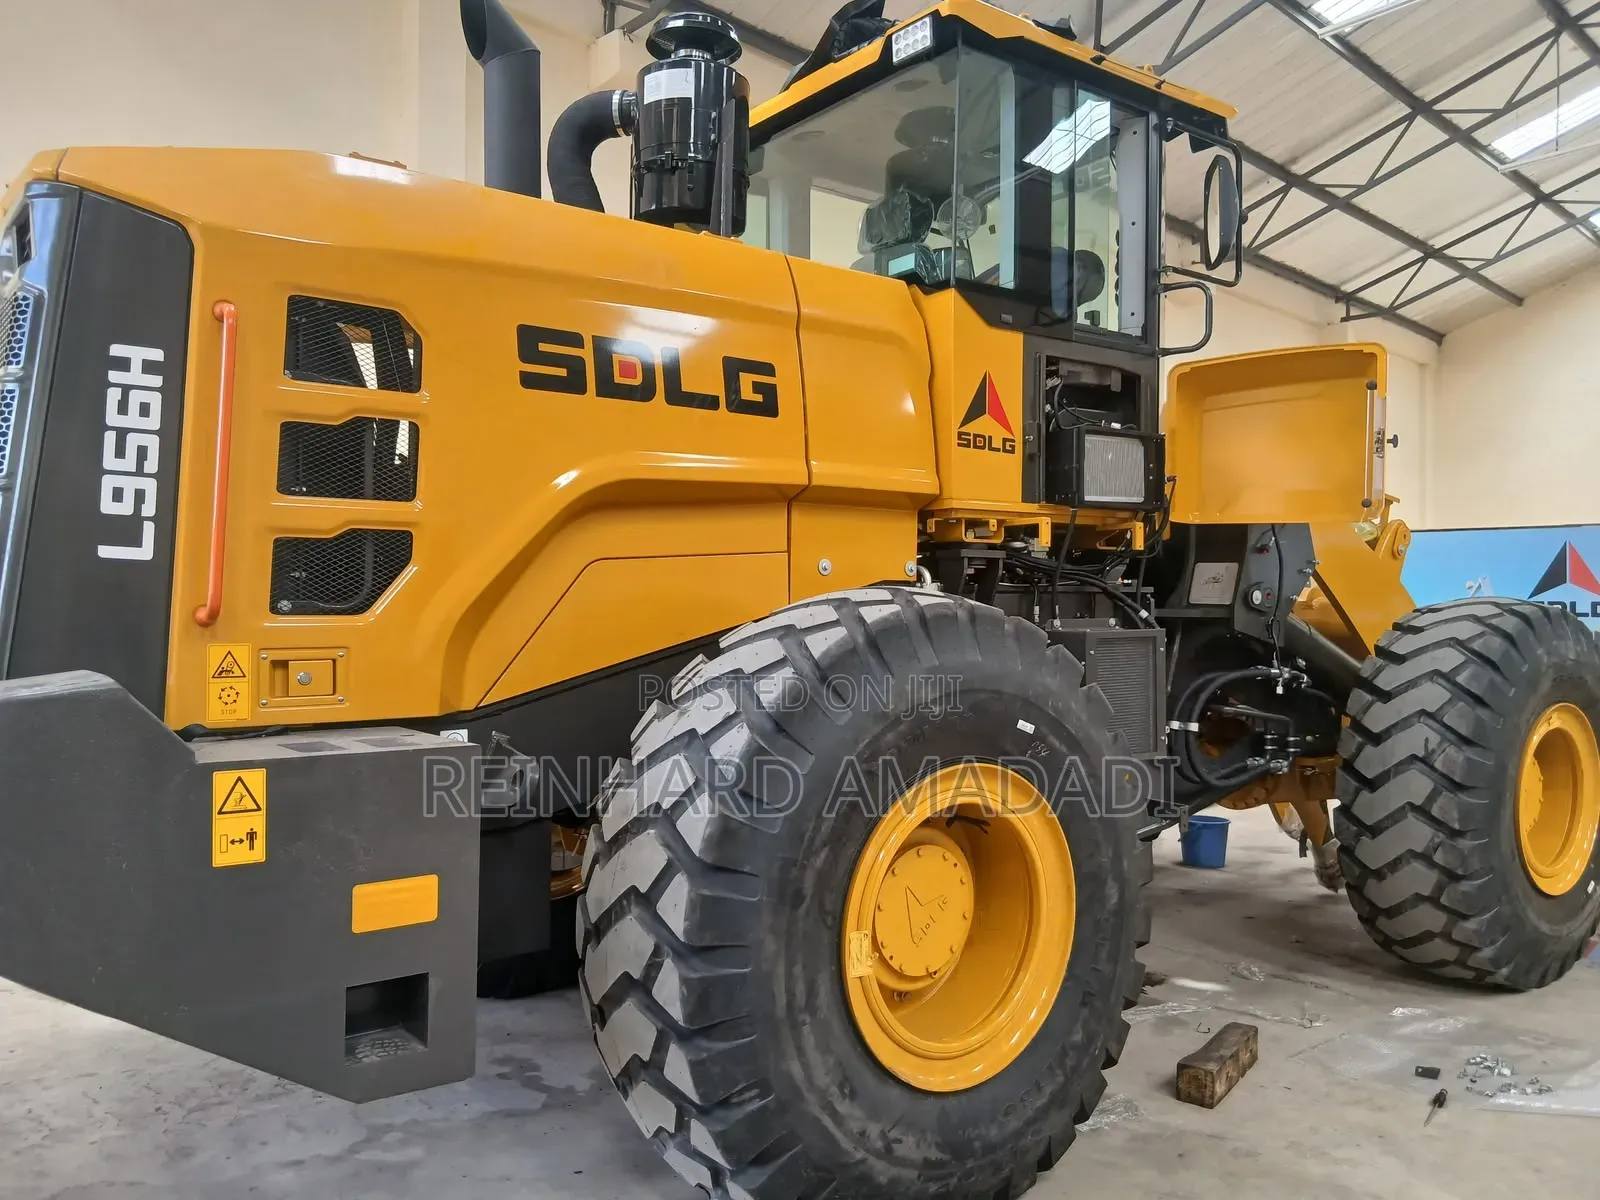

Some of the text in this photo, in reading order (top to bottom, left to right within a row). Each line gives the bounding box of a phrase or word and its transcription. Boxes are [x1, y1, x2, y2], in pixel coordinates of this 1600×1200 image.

[516, 324, 779, 418] SDLG
[97, 343, 165, 561] L956H
[957, 431, 1016, 455] SDLG
[220, 708, 237, 716] STOP
